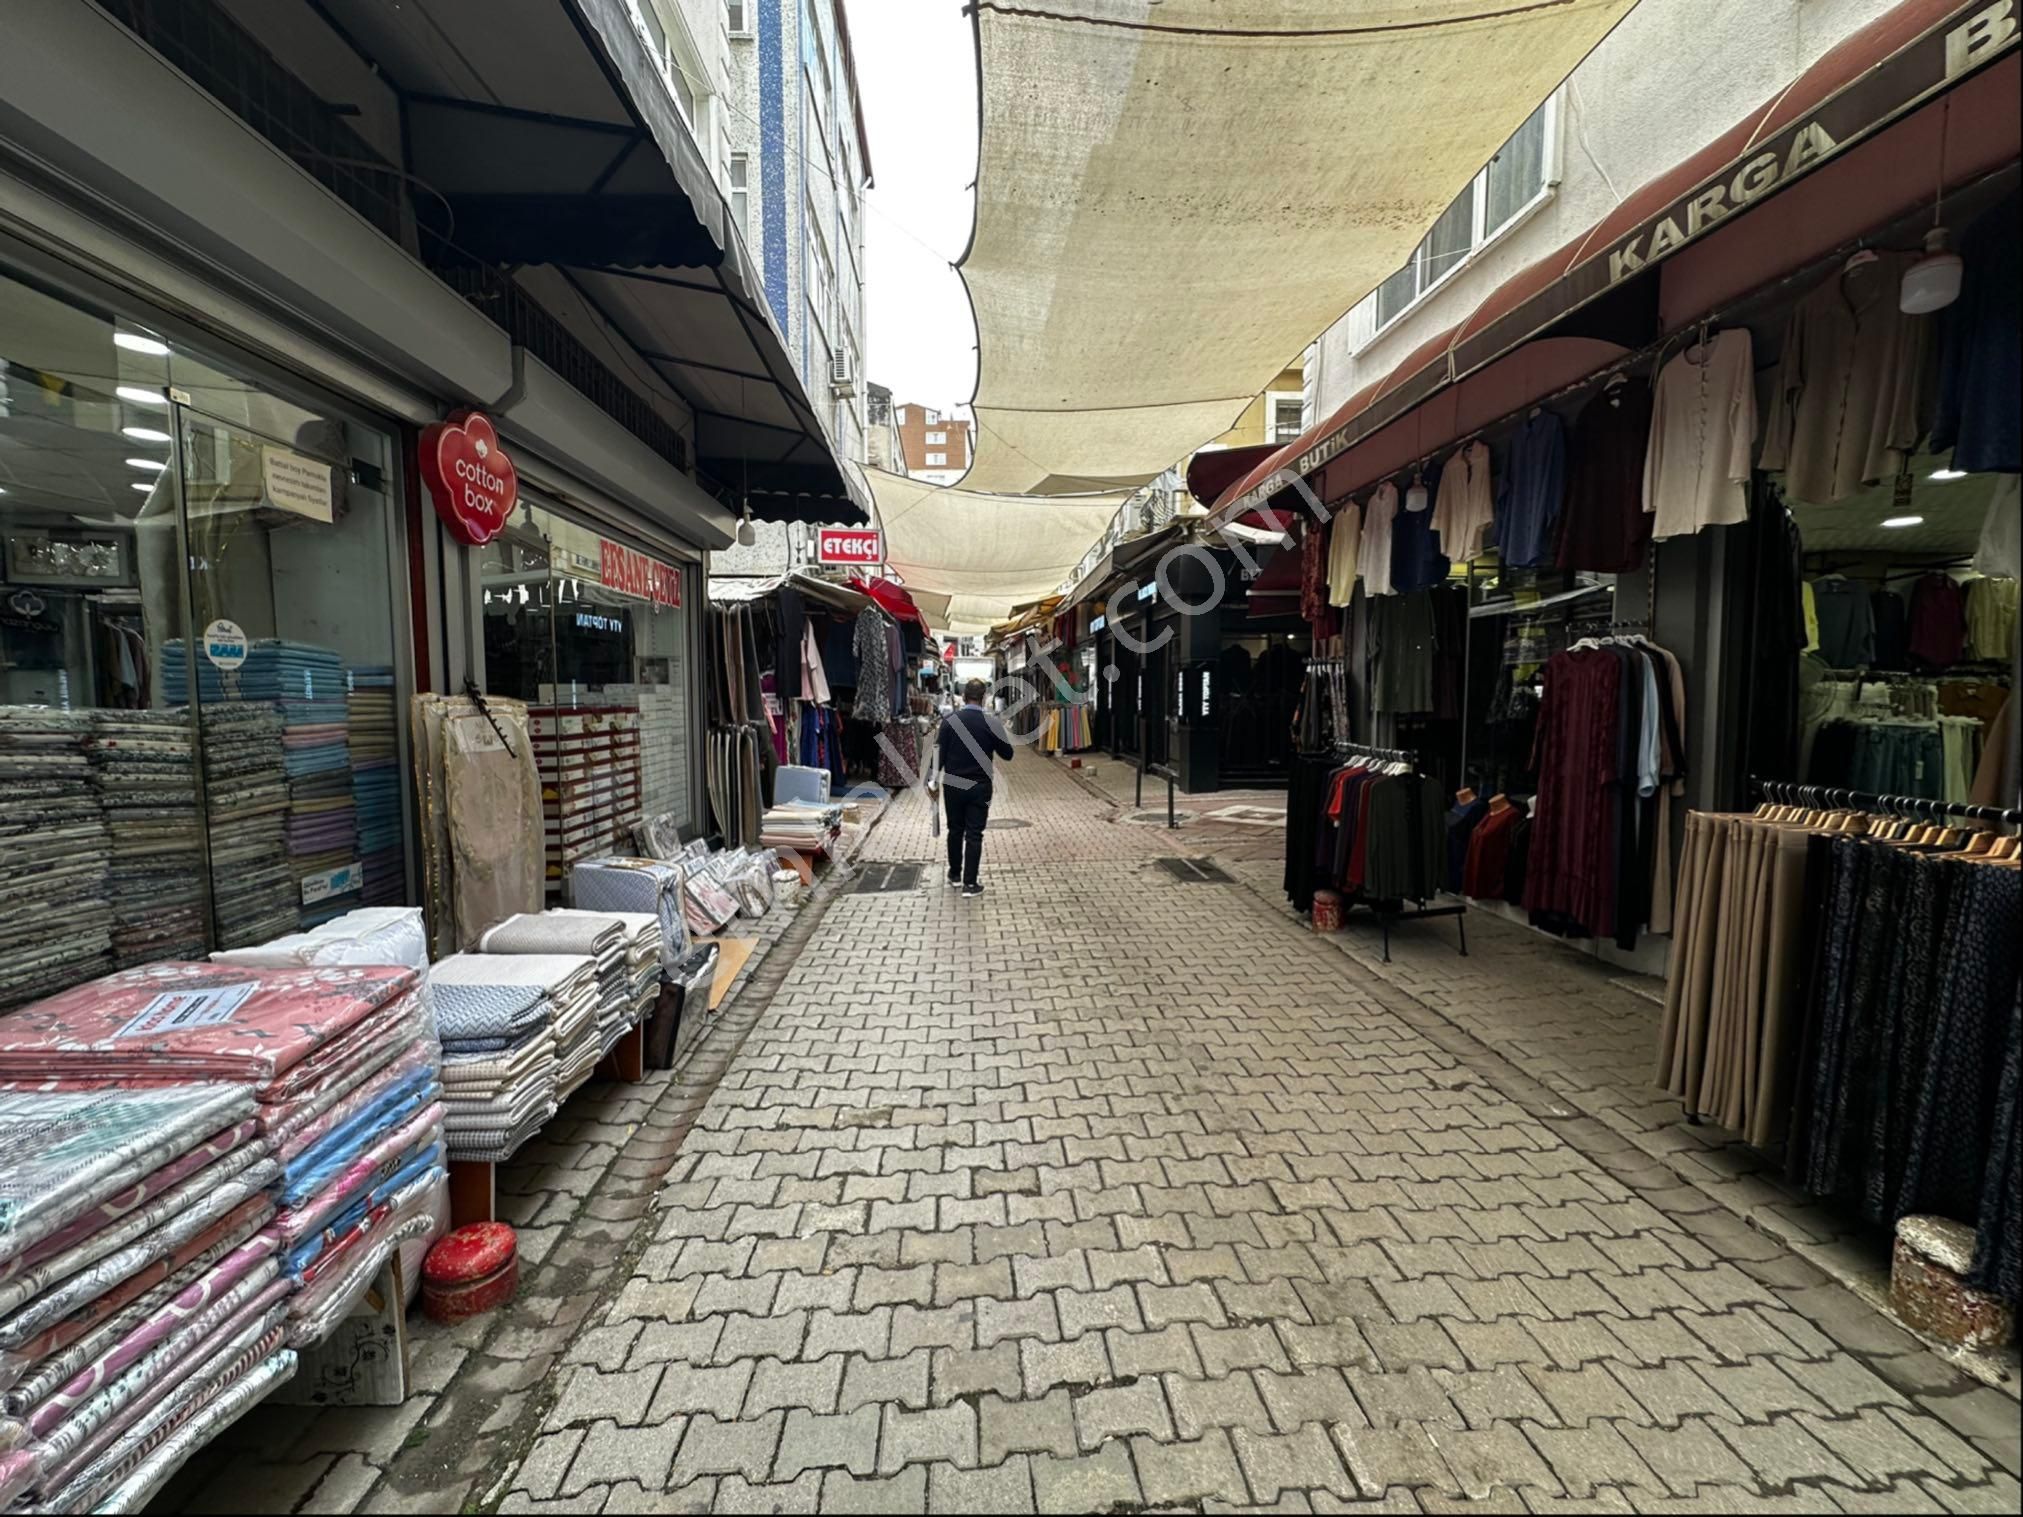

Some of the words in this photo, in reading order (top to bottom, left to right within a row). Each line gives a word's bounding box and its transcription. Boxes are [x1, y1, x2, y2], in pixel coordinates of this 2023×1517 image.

[1608, 121, 1837, 284] KARGA
[455, 458, 504, 496] cotton
[464, 483, 494, 516] box
[823, 534, 878, 560] ETEKÇİ
